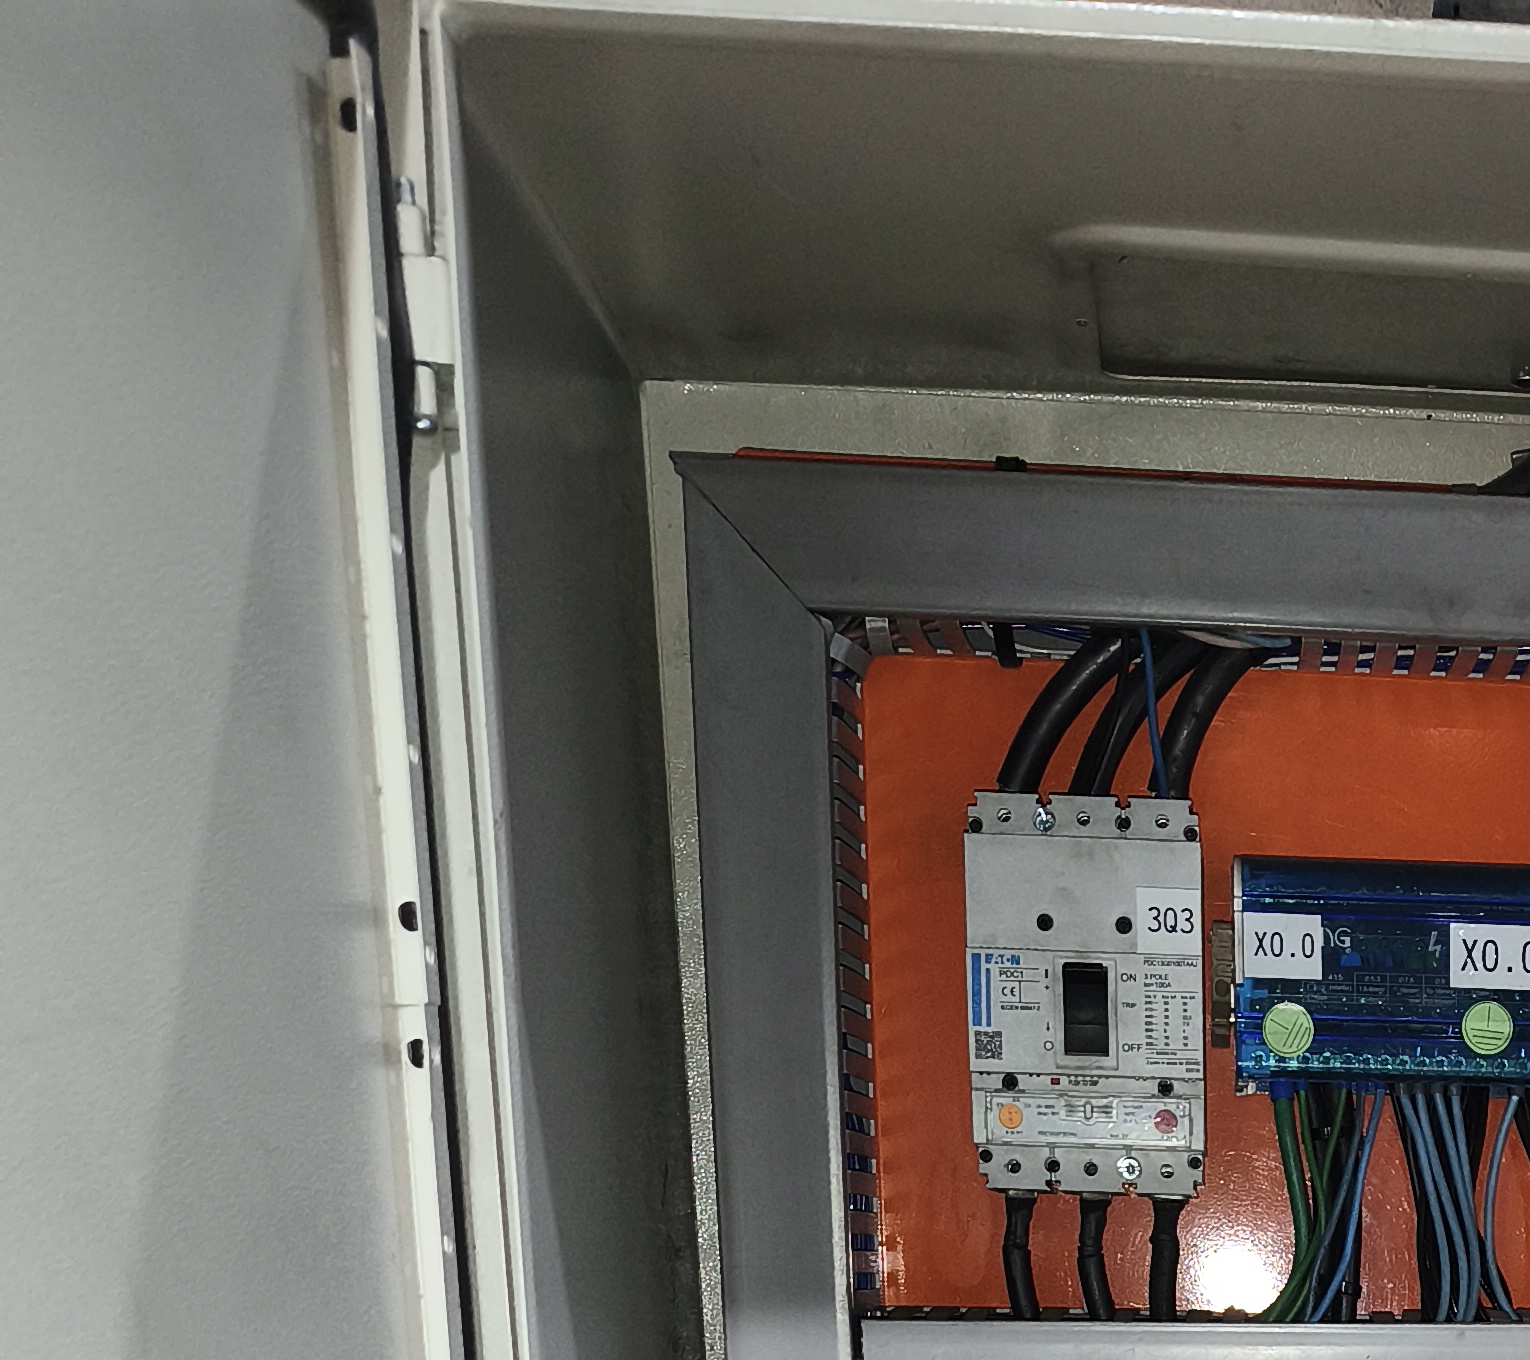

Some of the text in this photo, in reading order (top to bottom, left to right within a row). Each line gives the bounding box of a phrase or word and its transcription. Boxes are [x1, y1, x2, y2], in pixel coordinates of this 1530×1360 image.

[1148, 906, 1194, 934] 3Q3
[1253, 931, 1315, 958] X0.0
[999, 970, 1024, 979] PDC1
[1120, 973, 1137, 982] ON
[1121, 1043, 1143, 1053] OFF
